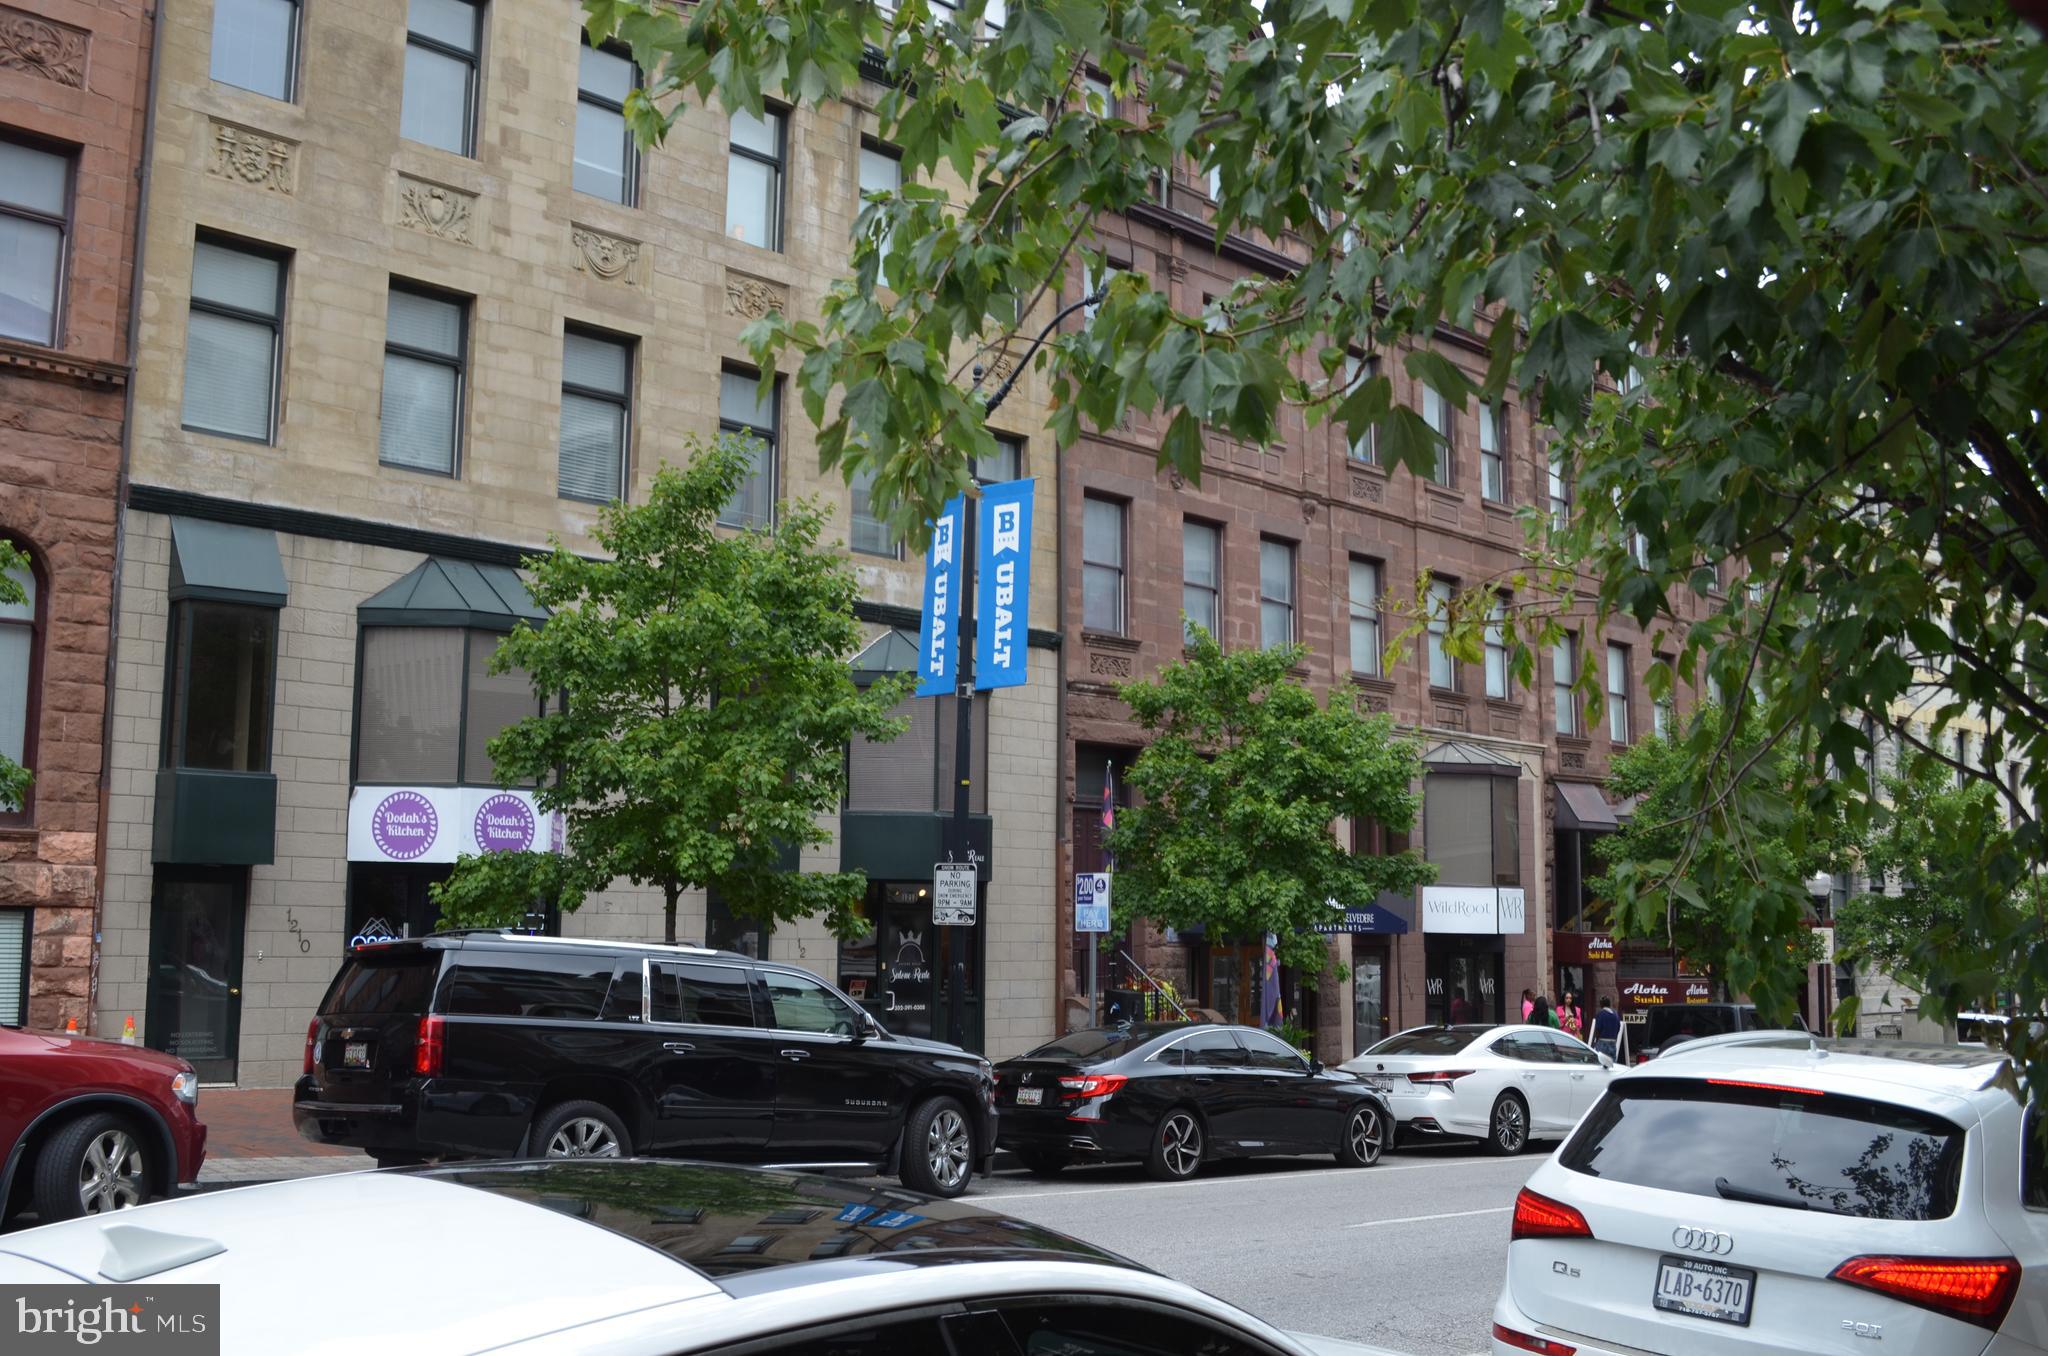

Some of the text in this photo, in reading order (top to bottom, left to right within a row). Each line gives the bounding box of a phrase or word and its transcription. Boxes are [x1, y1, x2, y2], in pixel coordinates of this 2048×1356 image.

[999, 511, 1015, 533] B
[993, 561, 1014, 668] UBALT
[930, 572, 948, 676] UBALT
[384, 811, 428, 824] Dodah's
[485, 813, 526, 827] Dodah's
[386, 825, 425, 837] Kitchen
[487, 826, 523, 840] Kitchen
[950, 871, 961, 879] NO
[939, 880, 970, 888] PARKING
[1096, 880, 1103, 888] 4
[1428, 900, 1491, 917] WildRoot
[1344, 913, 1374, 923] ELVEDERE
[1588, 937, 1613, 949] Aloha
[1624, 983, 1669, 995] Aloha
[1686, 983, 1709, 996] Aloha
[1633, 995, 1664, 1004] Sushi
[1552, 1260, 1581, 1278] Q5
[1693, 1262, 1713, 1271] AUTO
[1714, 1266, 1728, 1275] INC
